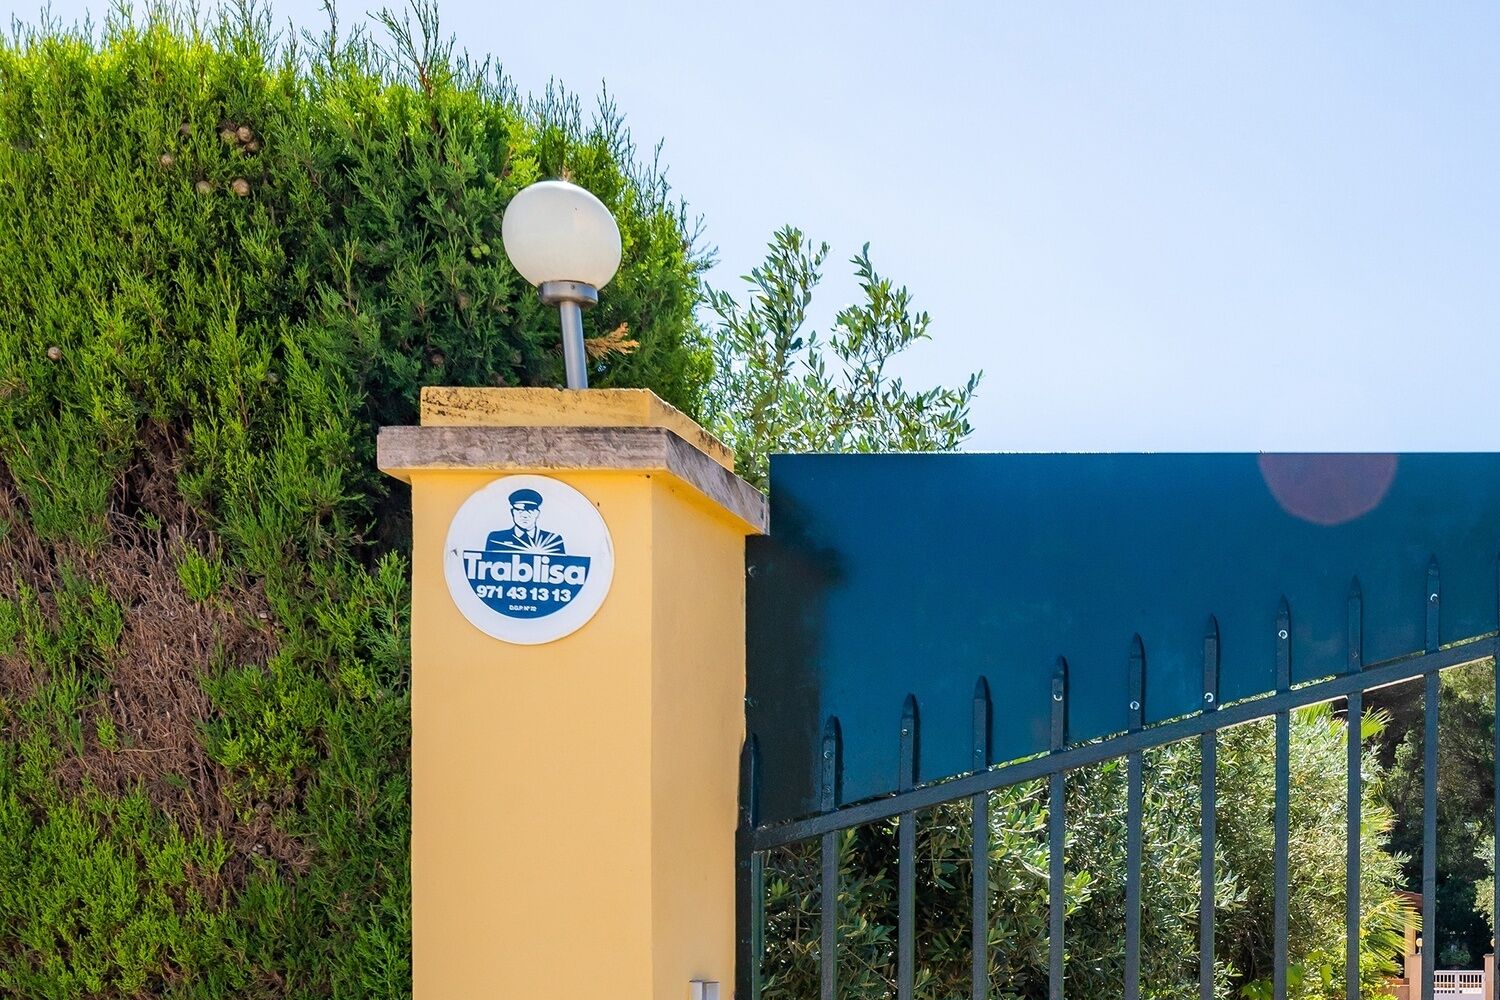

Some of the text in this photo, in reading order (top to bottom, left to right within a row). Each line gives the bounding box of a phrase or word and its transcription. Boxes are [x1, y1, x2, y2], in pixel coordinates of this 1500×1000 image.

[464, 552, 585, 585] Trablisa
[476, 585, 572, 602] 971 43 13 13
